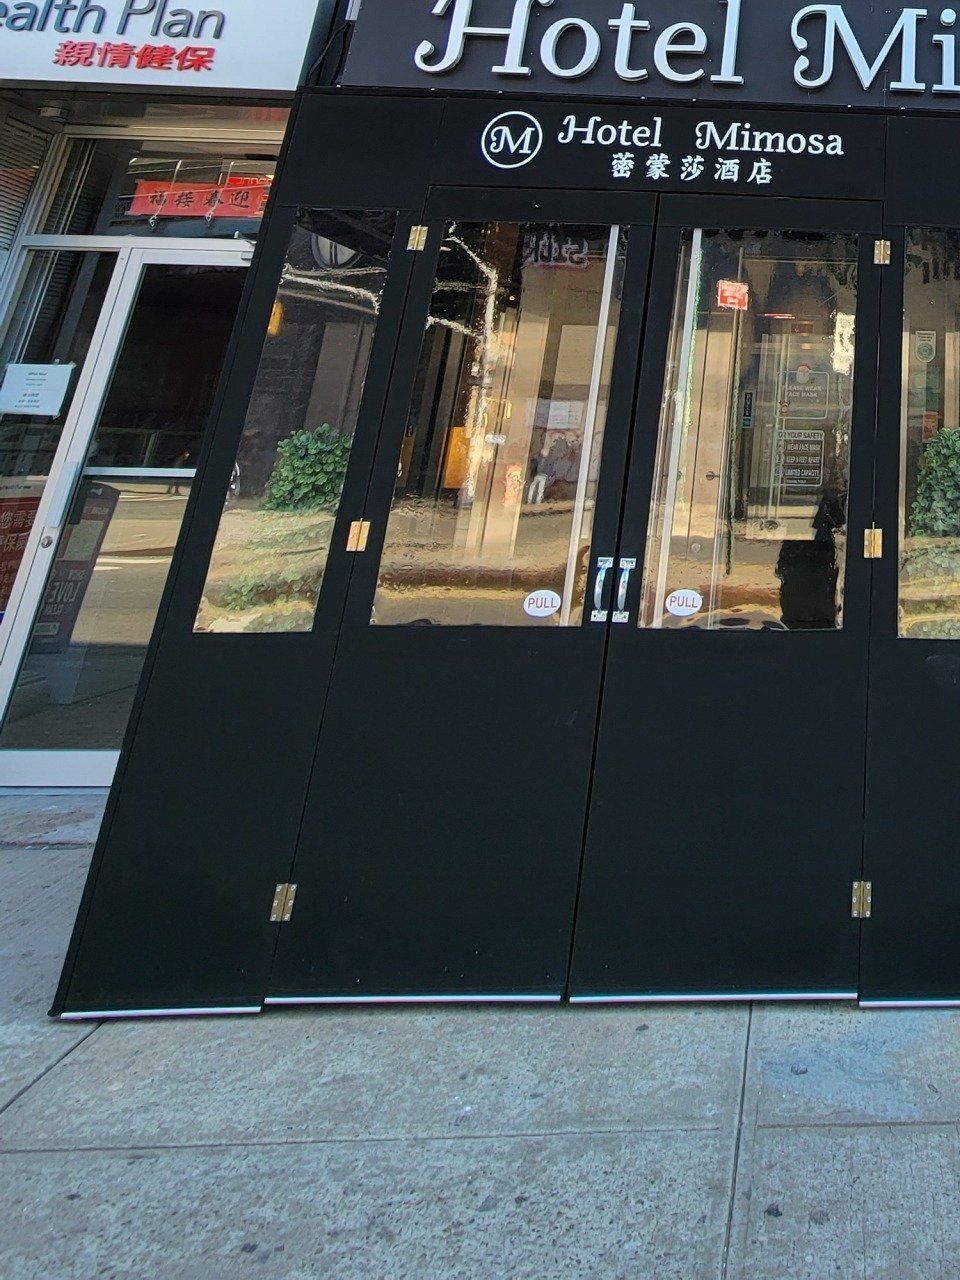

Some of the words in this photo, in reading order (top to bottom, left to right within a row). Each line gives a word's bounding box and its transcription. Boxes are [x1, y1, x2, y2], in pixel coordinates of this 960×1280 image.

[53, 40, 215, 71] 親情健保
[557, 114, 663, 148] Hotel
[694, 121, 844, 156] Mimosa
[803, 431, 824, 440] SAFETY
[527, 597, 557, 609] PULL
[669, 595, 698, 608] PULL
